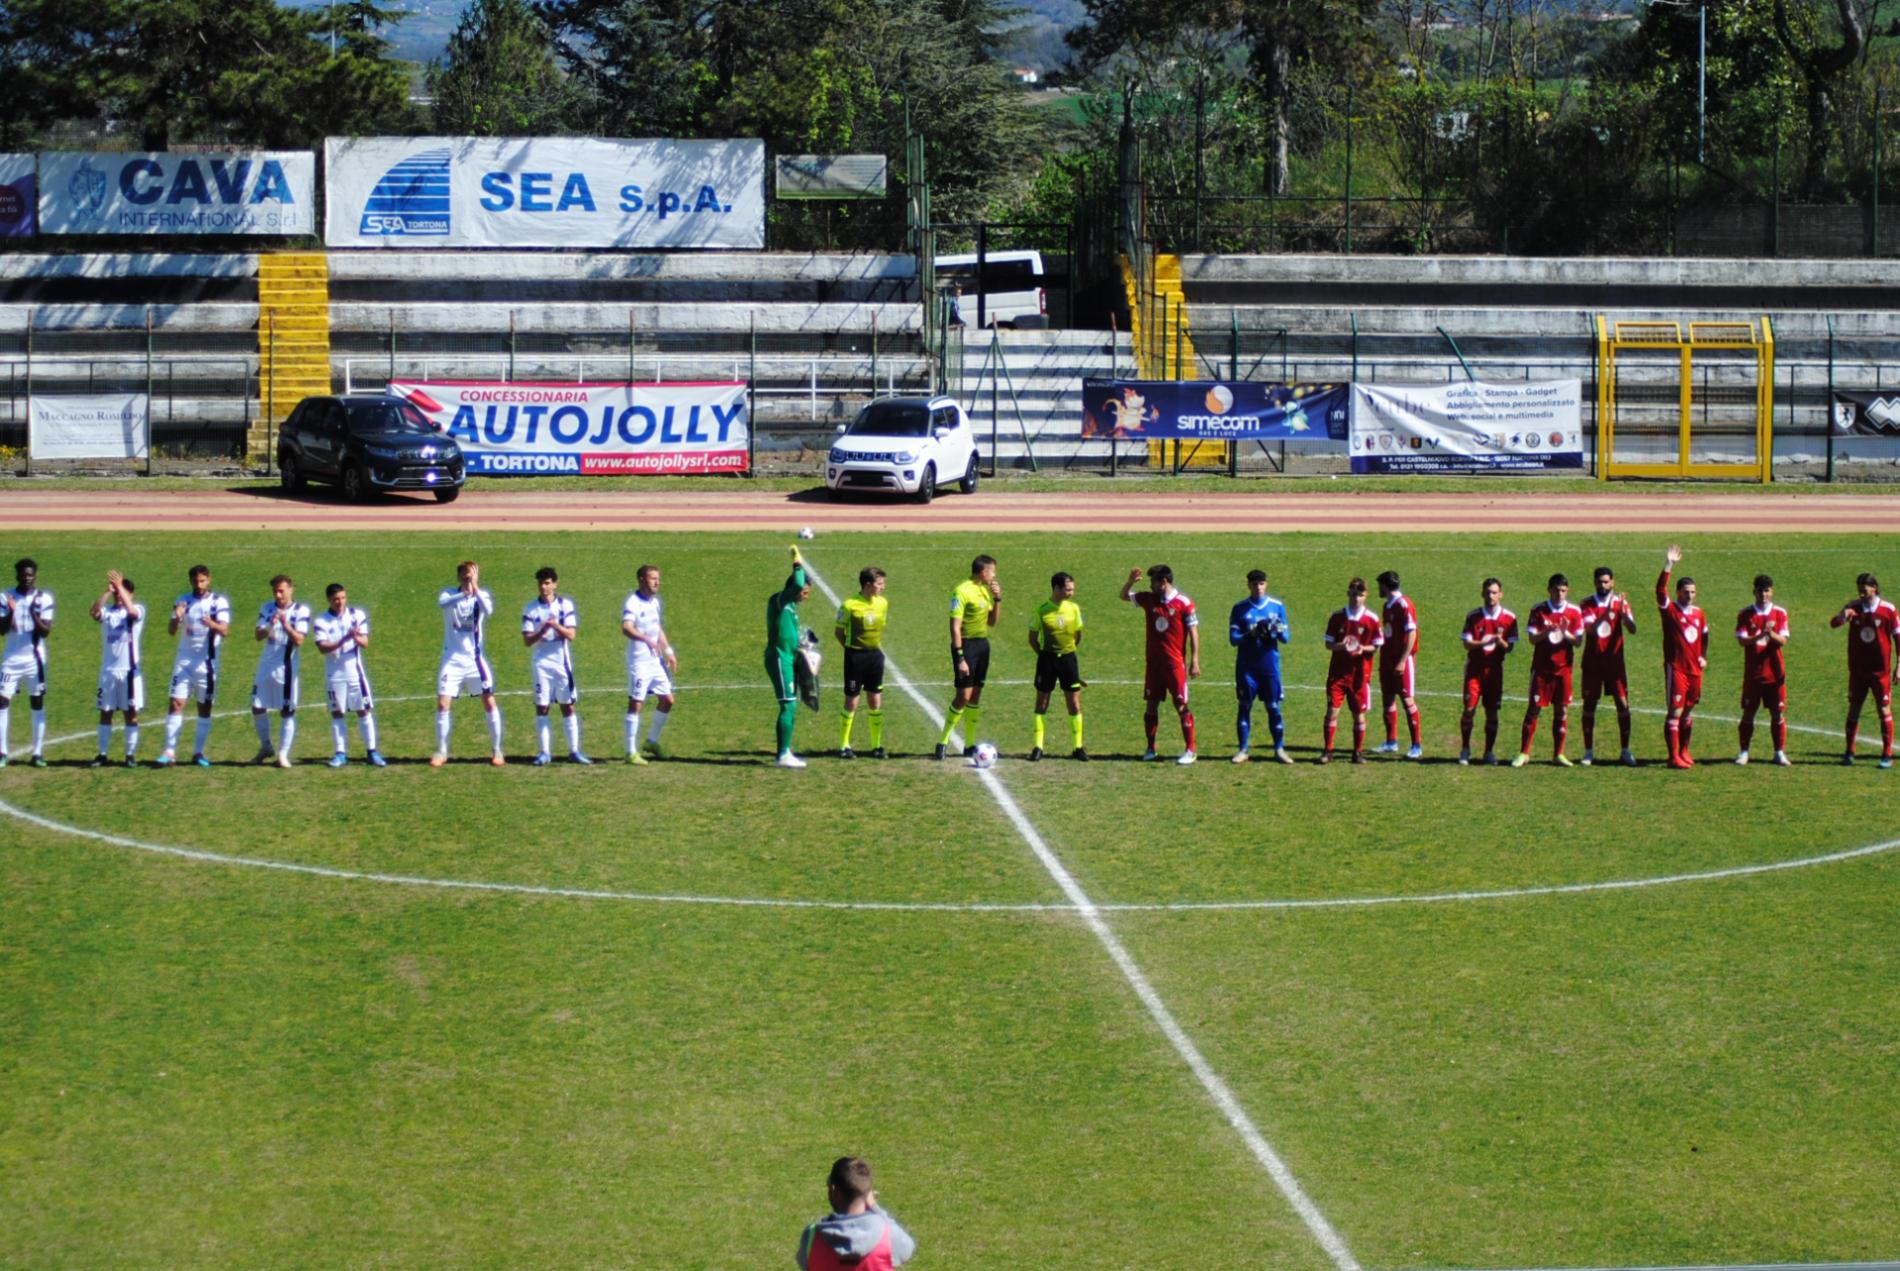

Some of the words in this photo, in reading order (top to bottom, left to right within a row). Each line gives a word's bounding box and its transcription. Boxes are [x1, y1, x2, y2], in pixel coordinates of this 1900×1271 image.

[119, 158, 295, 206] CAVA
[479, 172, 597, 213] SEA
[619, 184, 732, 220] S.p.A.
[119, 212, 260, 227] INTERNATIONAL
[362, 216, 406, 233] SEA
[407, 221, 447, 229] TORTONA
[459, 390, 589, 404] CONCESSIONARIA
[1485, 389, 1518, 399] Stampa
[1525, 387, 1558, 398] Gadget
[1512, 399, 1576, 410] personalizzato
[39, 411, 95, 421] MACCAGNO
[1177, 415, 1260, 431] simecom
[1471, 412, 1497, 422] social
[1505, 410, 1554, 421] multimedia
[446, 404, 745, 445] AUTOJOLLY
[481, 453, 579, 471] TORTONA
[584, 453, 742, 470] www.autojollysrl.com
